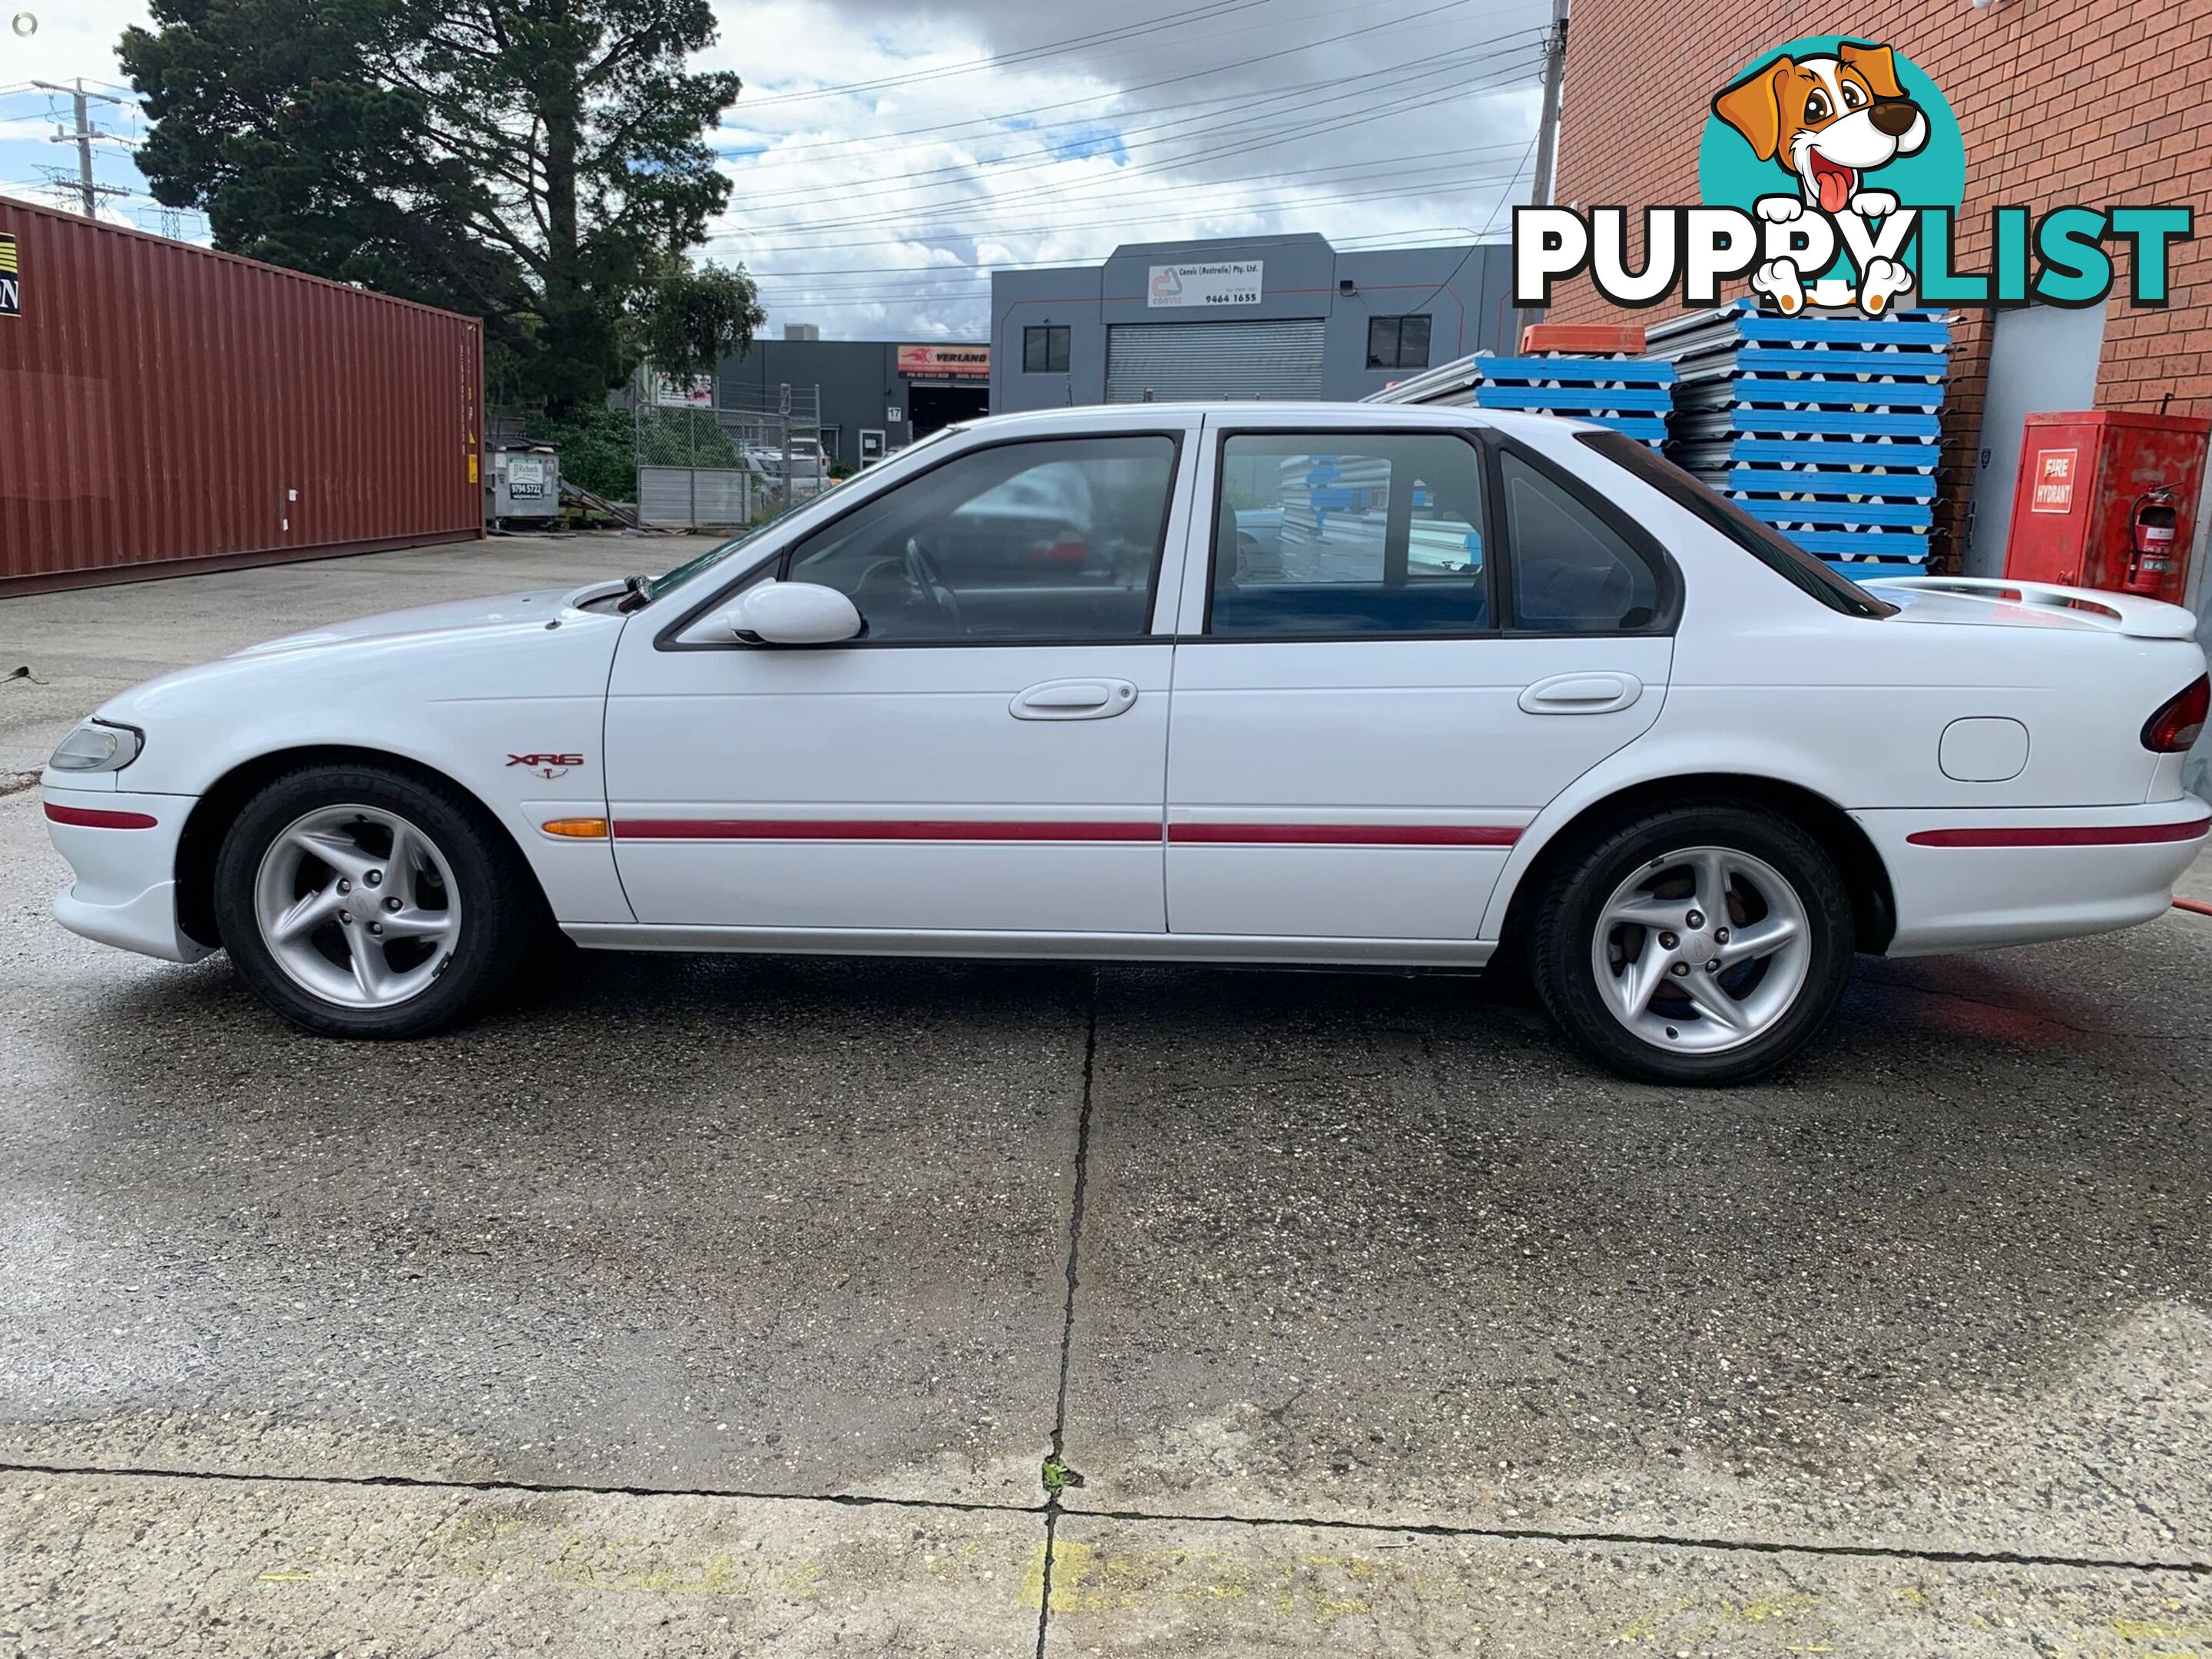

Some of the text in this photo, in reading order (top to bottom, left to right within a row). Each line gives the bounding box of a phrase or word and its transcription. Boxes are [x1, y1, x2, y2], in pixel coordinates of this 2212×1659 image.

[1179, 263, 1259, 276] Convic (Australia) Pty. Ltd.
[0, 278, 19, 310] N
[1205, 293, 1257, 304] 9464 1655
[889, 408, 901, 419] 17
[2044, 459, 2070, 478] FIRE
[511, 485, 541, 493] 9794 5722
[2036, 485, 2072, 504] HYDRANT
[505, 753, 584, 767] XR6
